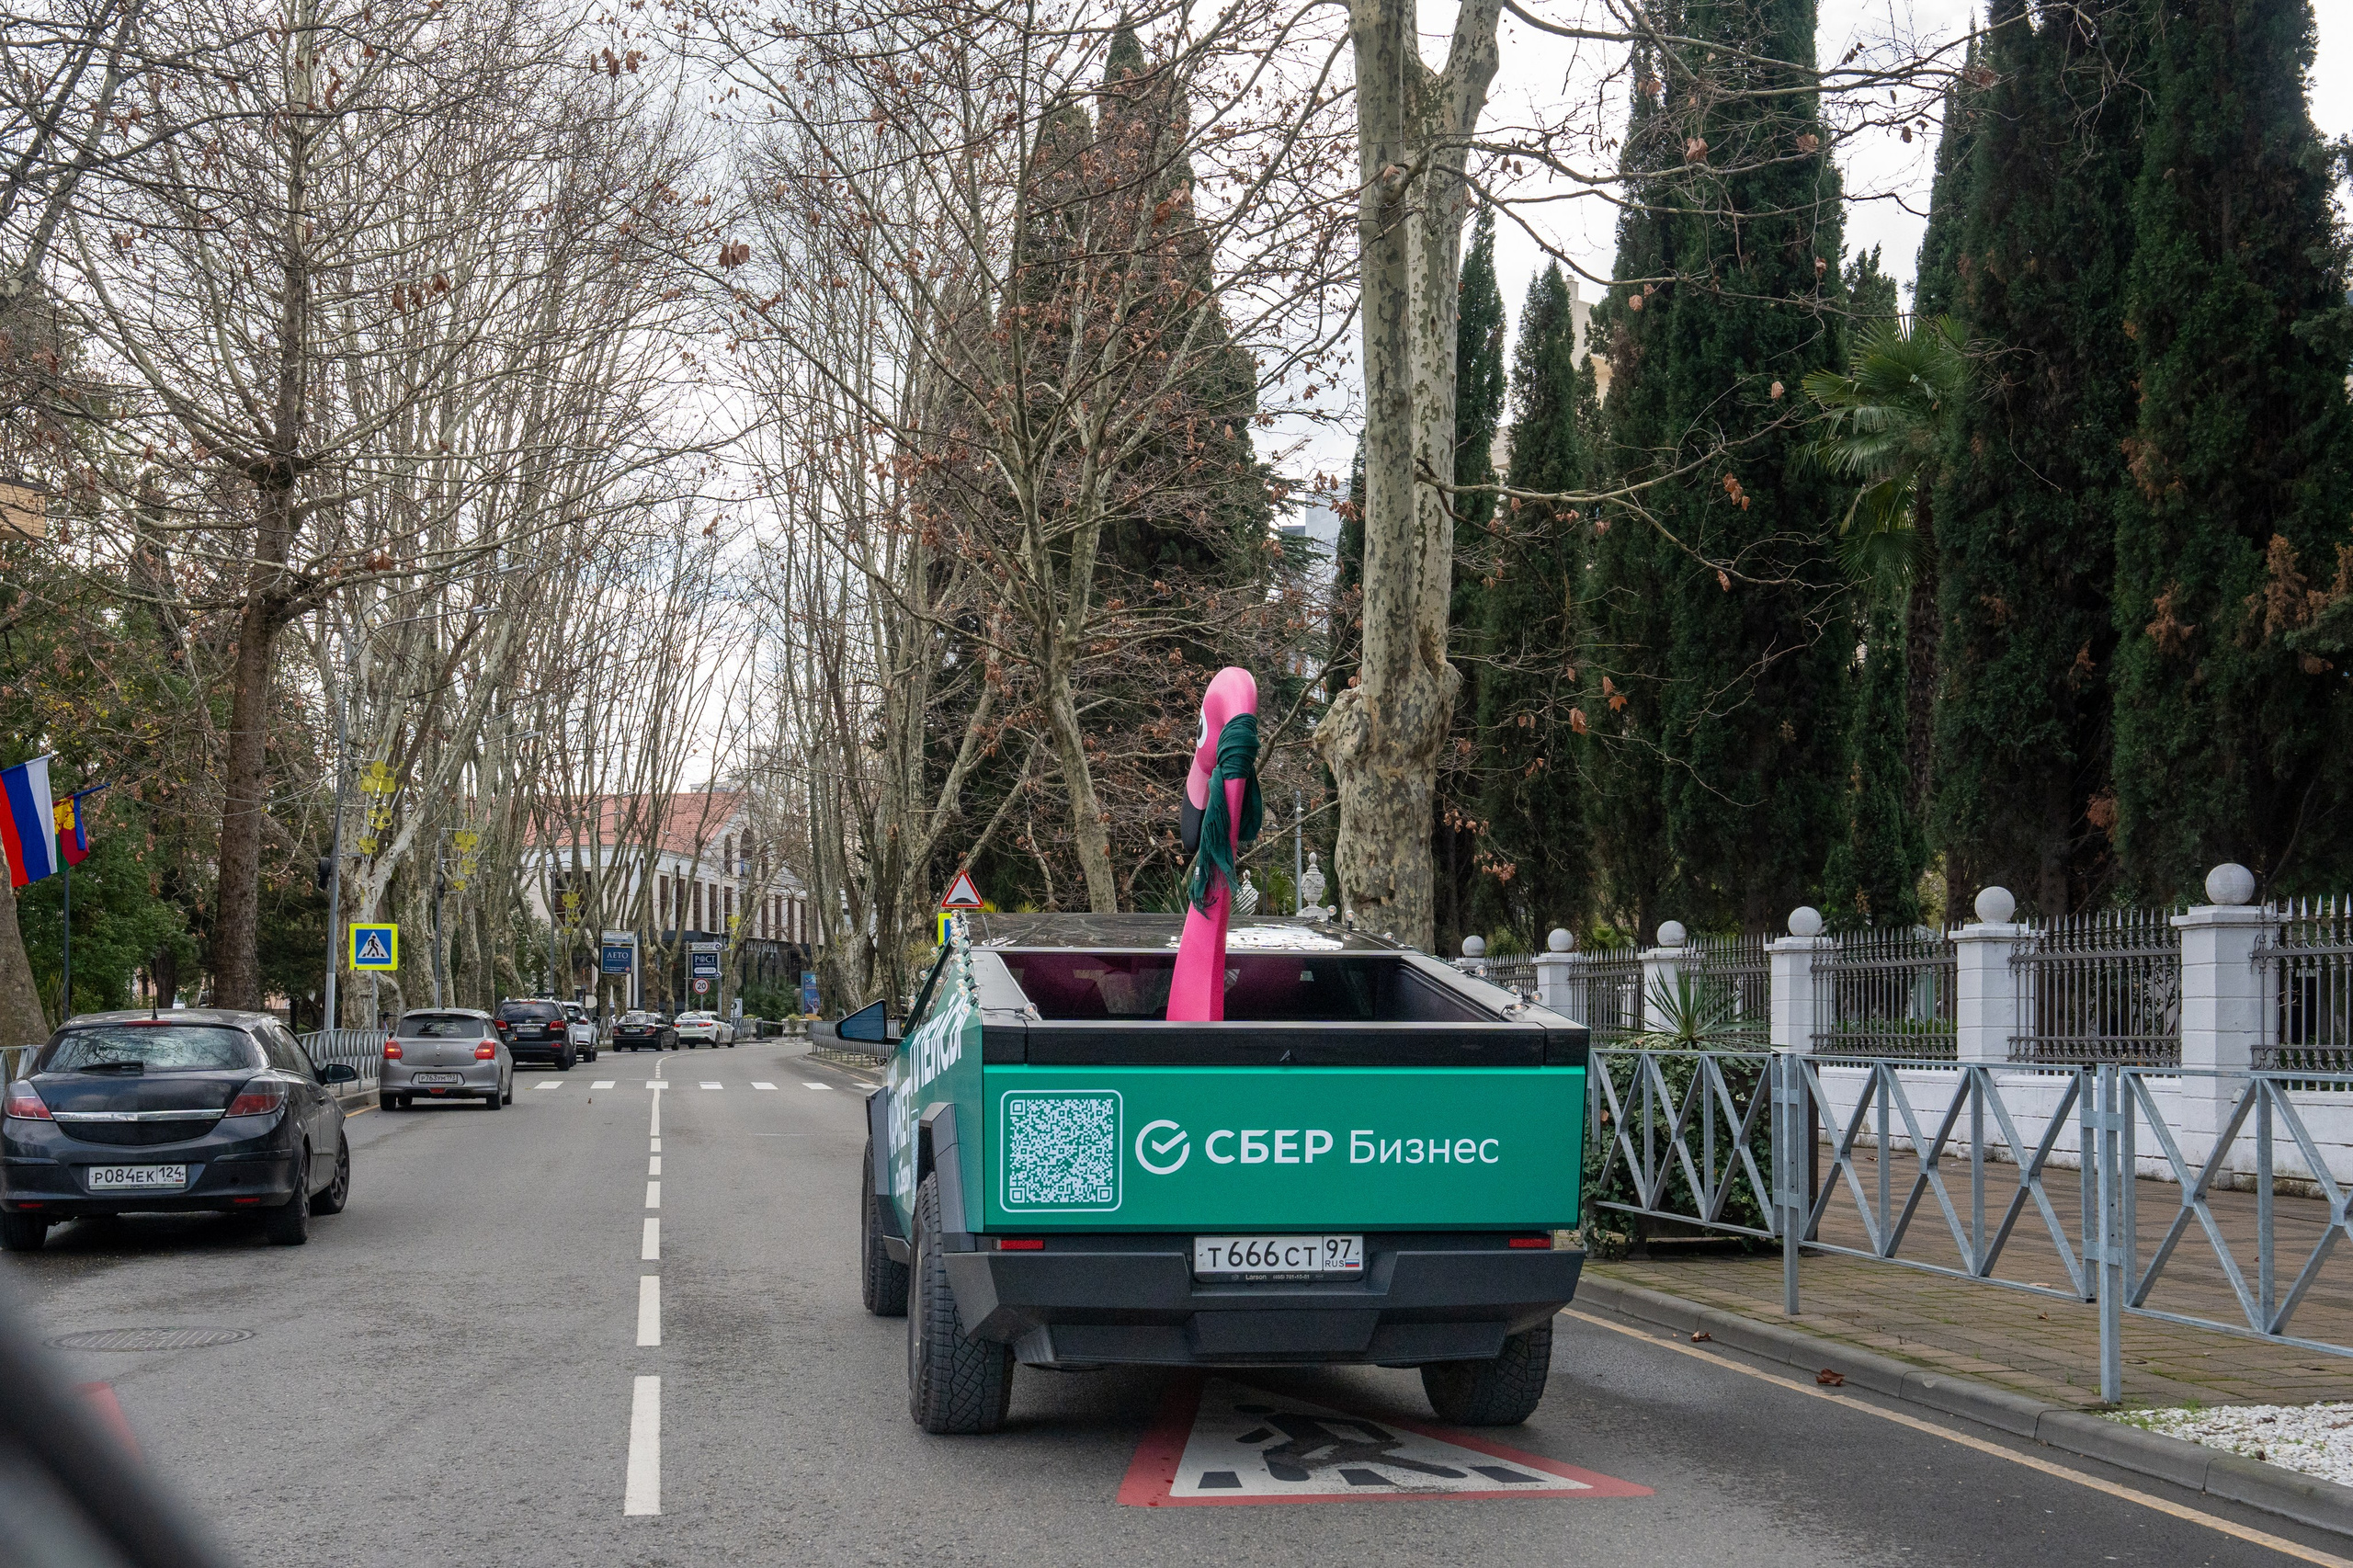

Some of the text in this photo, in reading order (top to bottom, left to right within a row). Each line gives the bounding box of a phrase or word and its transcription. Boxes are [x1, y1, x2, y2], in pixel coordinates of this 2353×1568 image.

[607, 951, 629, 960] ЛЕТО
[1205, 1129, 1499, 1165] СБЕР Бизнес
[95, 1166, 181, 1184] Р084ЕК 124
[1208, 1239, 1352, 1267] Т666СТ 97
